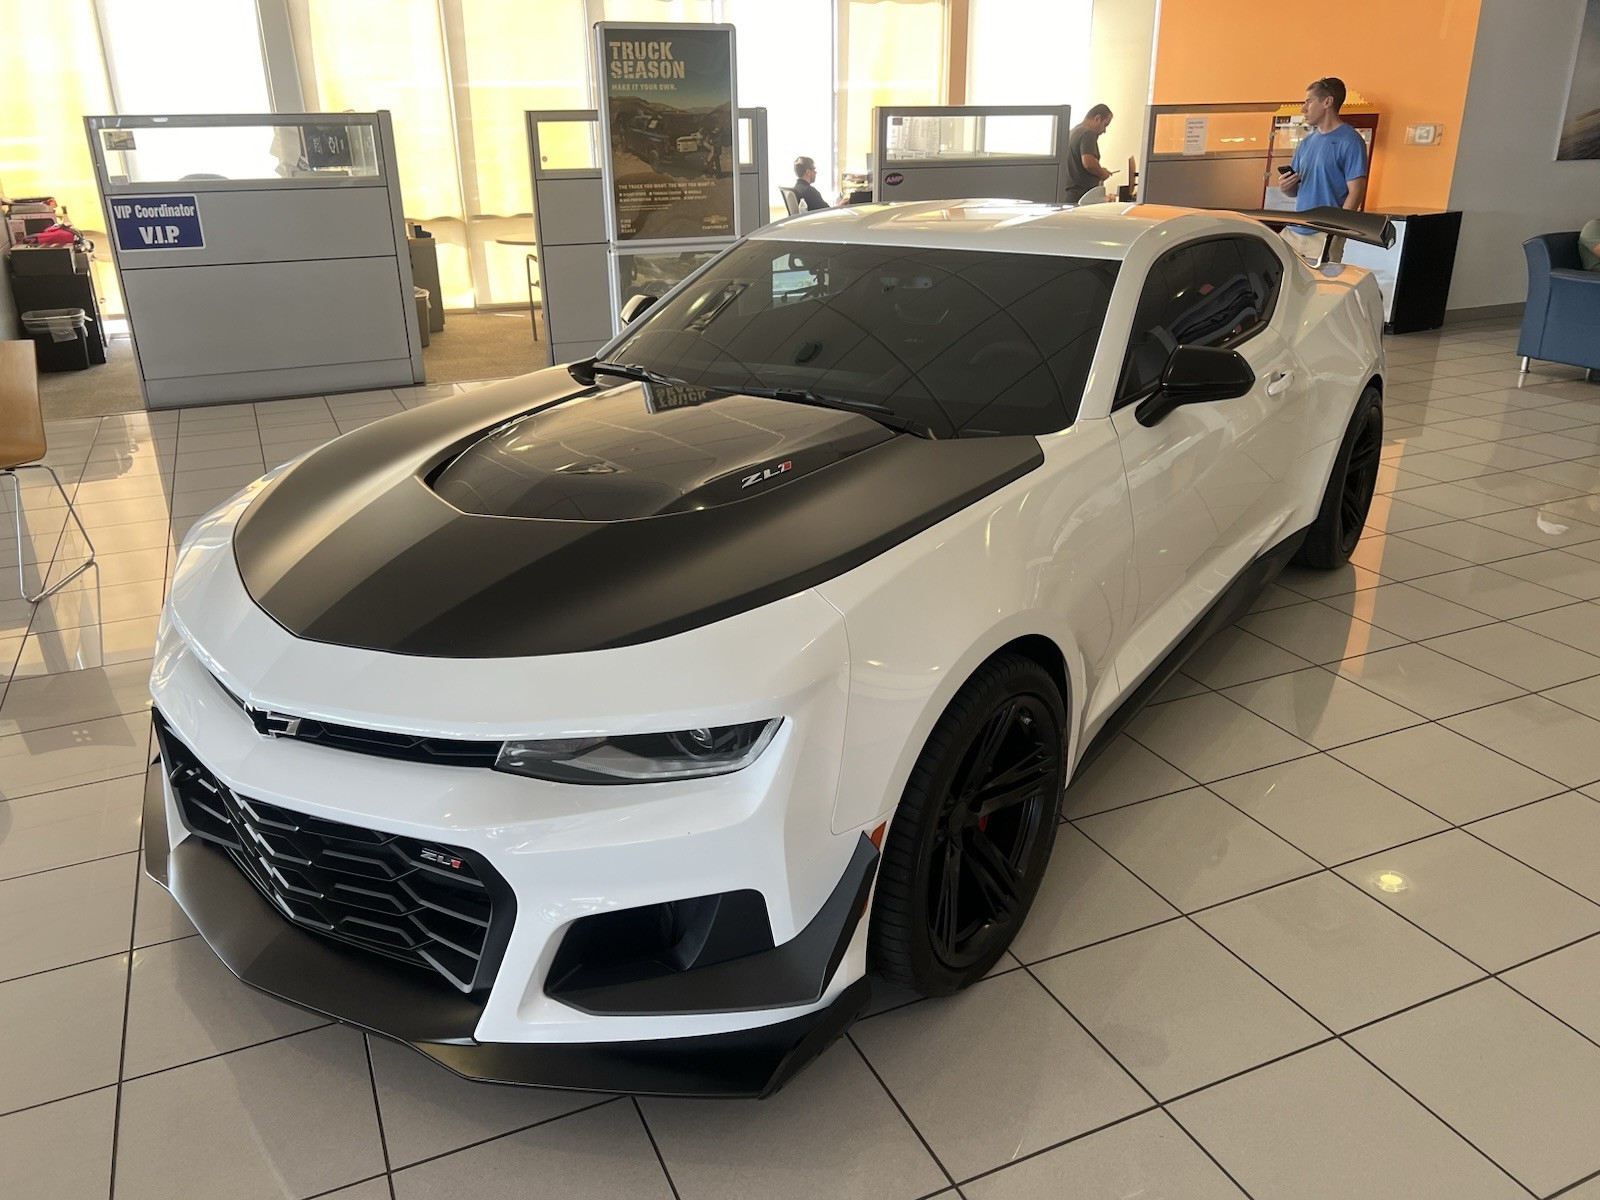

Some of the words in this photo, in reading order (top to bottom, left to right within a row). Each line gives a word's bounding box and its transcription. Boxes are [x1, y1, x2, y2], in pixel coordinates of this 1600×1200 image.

[609, 41, 673, 60] TRUCK
[610, 60, 685, 79] SEASON
[612, 83, 631, 91] MAKE
[632, 83, 639, 91] IT
[640, 83, 658, 91] YOUR
[659, 83, 677, 91] OWN.
[114, 205, 132, 219] VIP
[134, 204, 195, 218] Coordinator
[138, 225, 180, 244] V.I.P.
[741, 460, 792, 489] ZL1
[420, 849, 462, 869] ZL1
